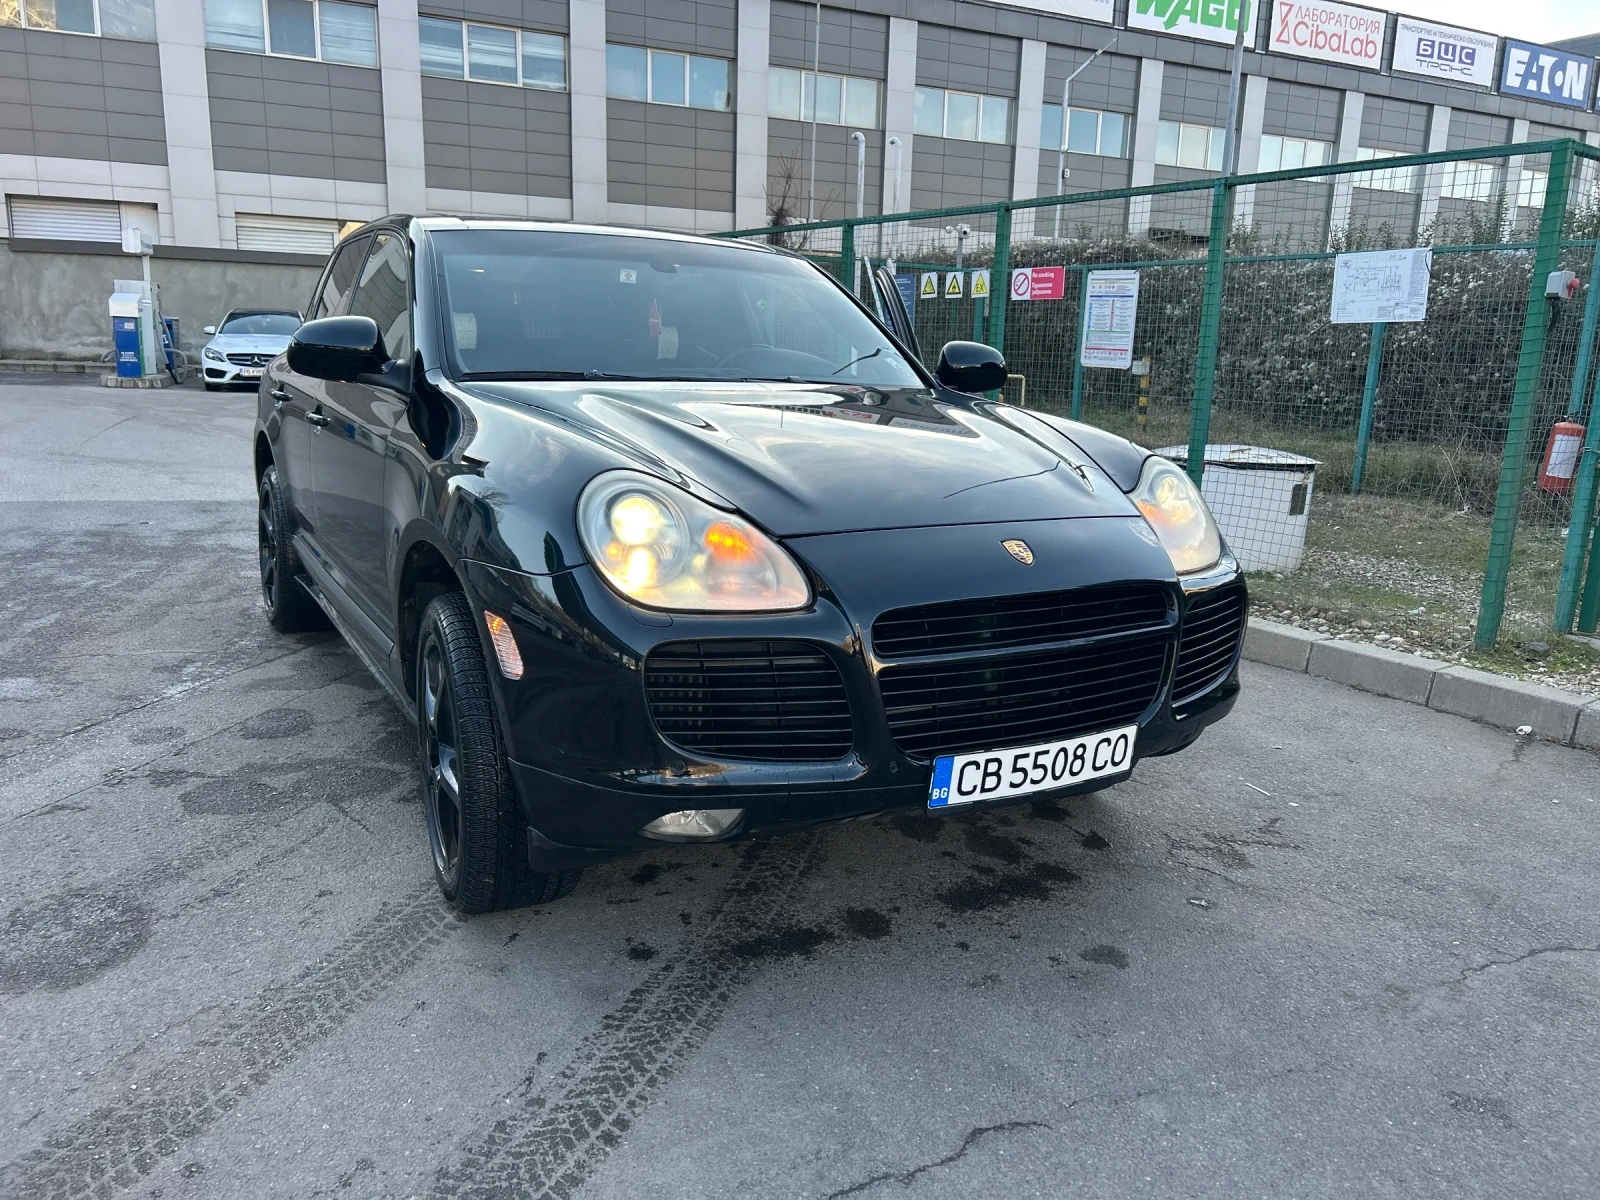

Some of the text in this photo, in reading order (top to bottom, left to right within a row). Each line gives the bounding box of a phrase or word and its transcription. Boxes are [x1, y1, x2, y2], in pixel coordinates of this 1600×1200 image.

[1295, 5, 1381, 34] ЛАБОРАТОРИЯ
[1401, 24, 1432, 36] ТРАНСПОРТНО
[1293, 20, 1377, 59] CibaLab
[1506, 48, 1588, 100] EATON
[1038, 271, 1055, 279] smoking
[975, 283, 984, 292] EX
[956, 733, 1129, 796] CB 5508 CO
[932, 787, 948, 800] BG
